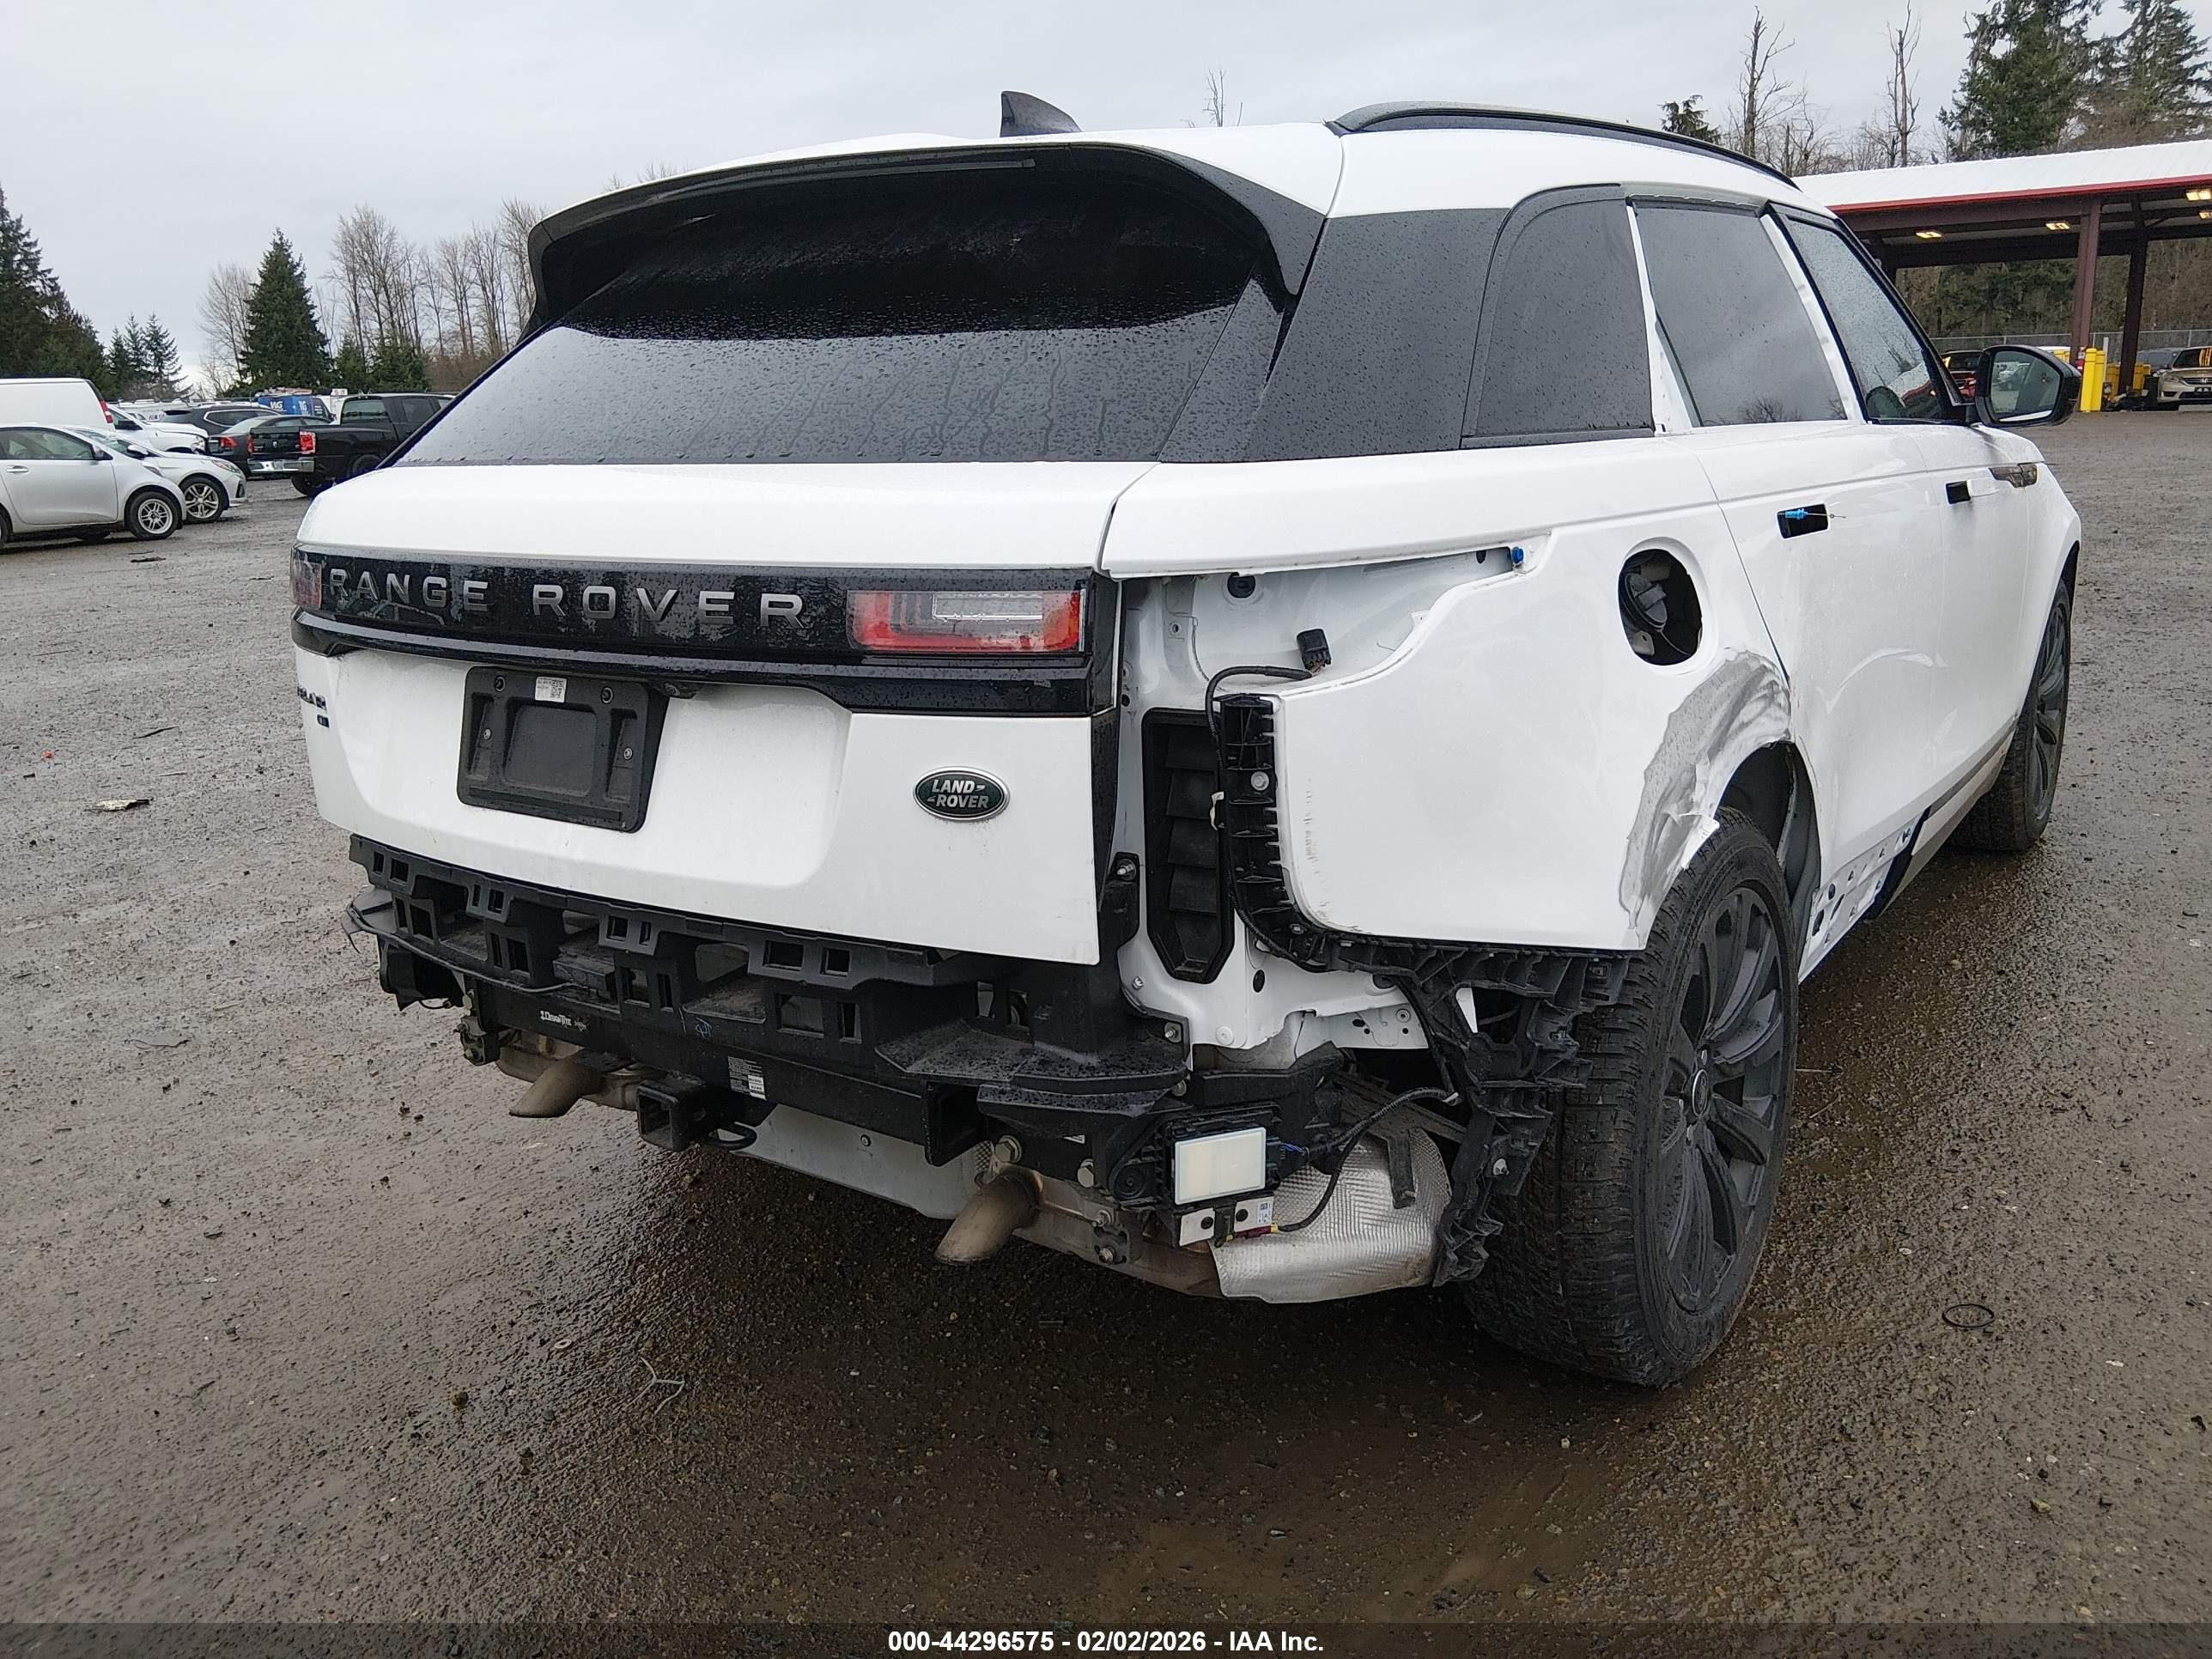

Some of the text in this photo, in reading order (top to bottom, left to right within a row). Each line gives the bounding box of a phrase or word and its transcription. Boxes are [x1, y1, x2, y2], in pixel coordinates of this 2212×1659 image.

[330, 568, 805, 629] RANGE ROVER
[932, 779, 975, 793] LAND
[936, 793, 989, 808] ROVER
